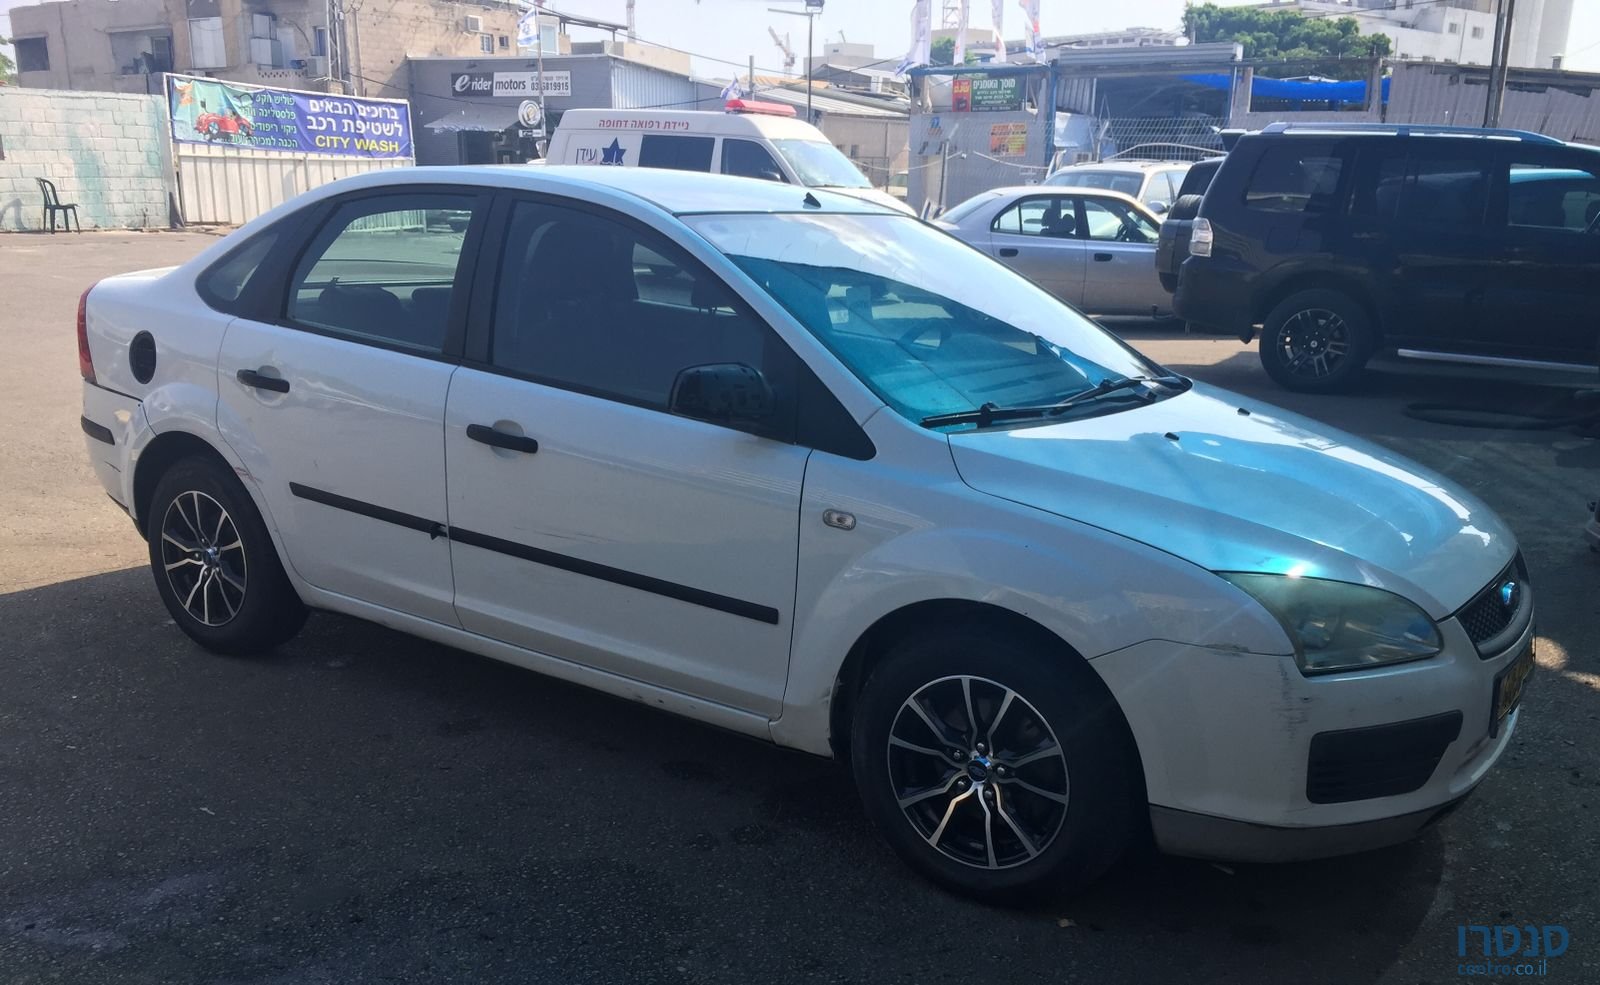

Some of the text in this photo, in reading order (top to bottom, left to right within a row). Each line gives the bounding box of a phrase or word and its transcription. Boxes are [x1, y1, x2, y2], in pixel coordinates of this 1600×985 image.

[471, 77, 492, 91] rider
[495, 79, 526, 90] motors
[999, 78, 1016, 91] מוסך
[273, 93, 295, 106] פוליש
[259, 107, 296, 120] פלסטלינה
[309, 99, 400, 120] ברוכים הבאים
[280, 124, 297, 135] ניקוי
[306, 115, 403, 137] לשטיפת רכב
[598, 119, 690, 130] ניידת רפואה דחופה
[278, 137, 298, 148] הכנה
[315, 134, 399, 153] CITY WASH
[575, 147, 598, 165] עידן
